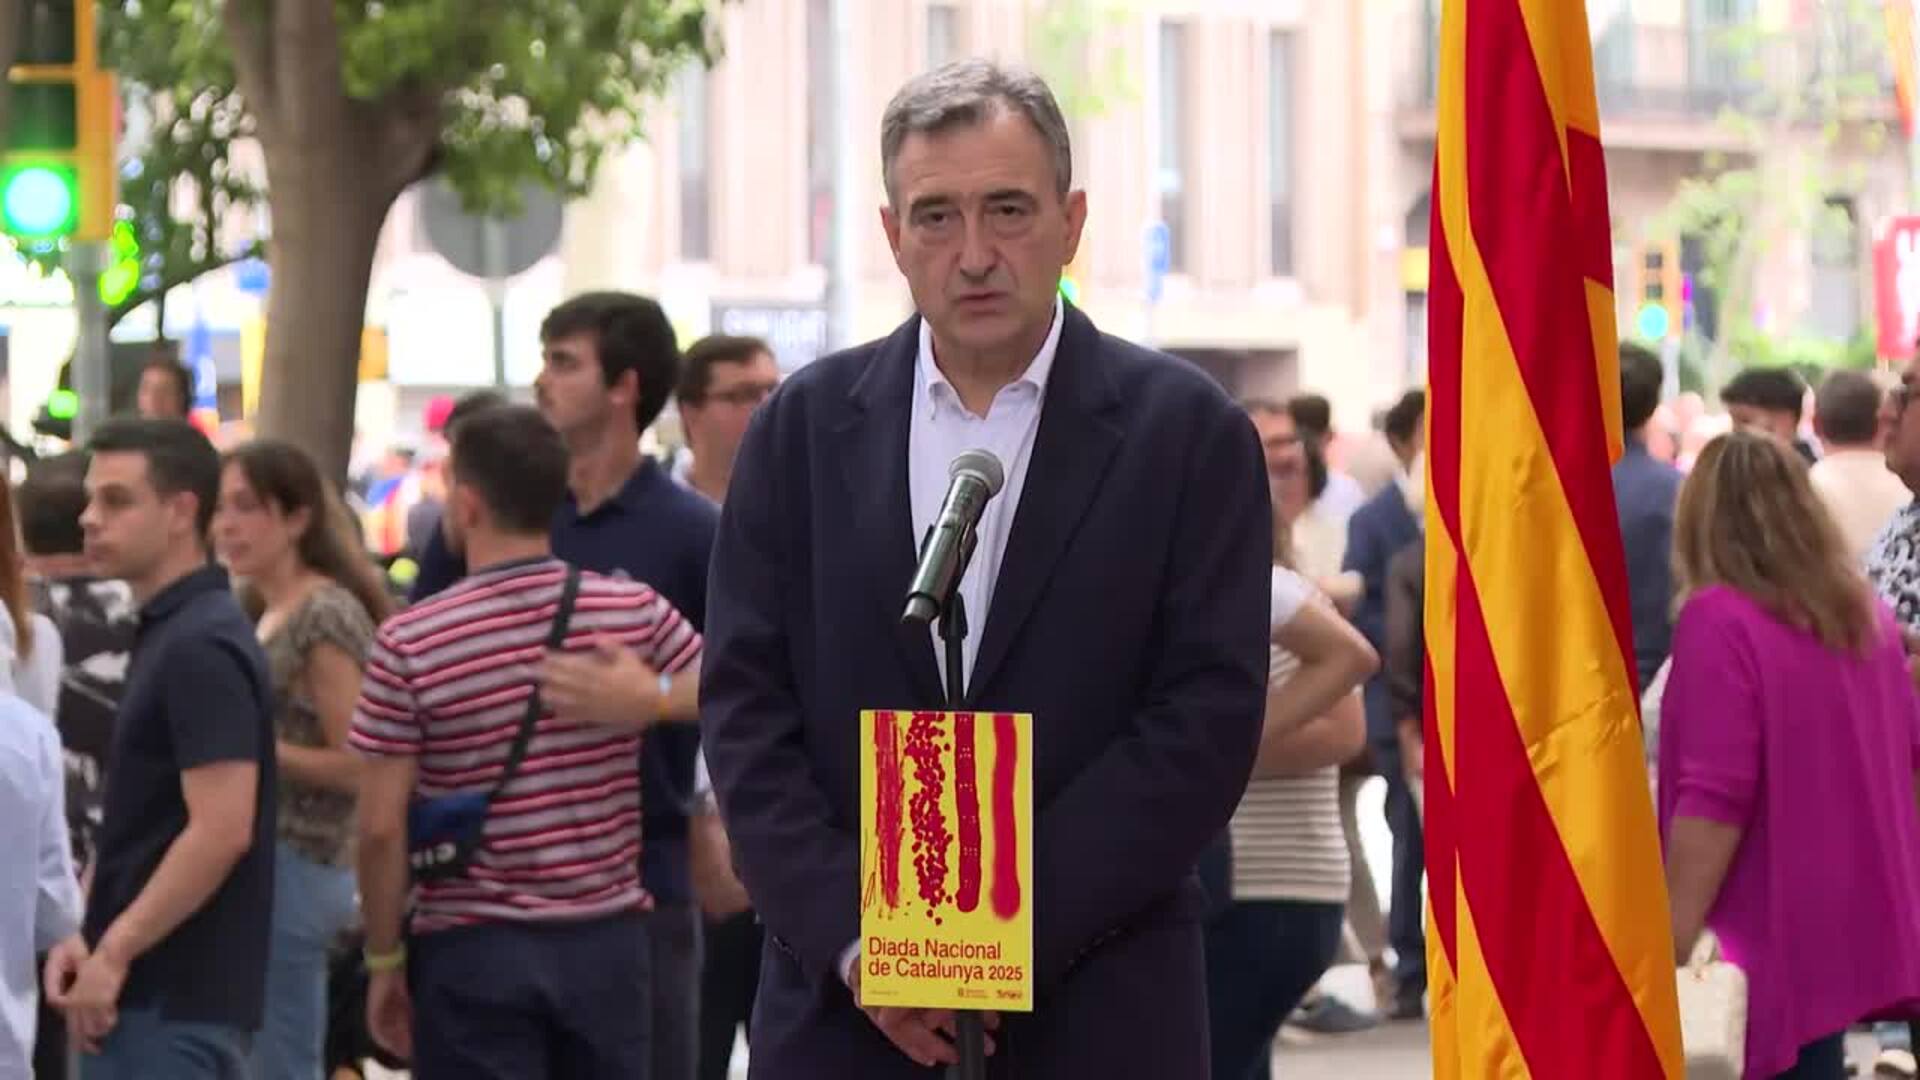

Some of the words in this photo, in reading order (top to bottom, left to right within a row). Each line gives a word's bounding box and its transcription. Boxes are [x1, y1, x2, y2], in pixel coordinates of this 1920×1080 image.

[868, 936, 919, 957] Diada
[924, 938, 1001, 960] Nacional
[868, 958, 890, 976] de
[895, 957, 984, 984] Catalunya
[988, 965, 1023, 981] 2025
